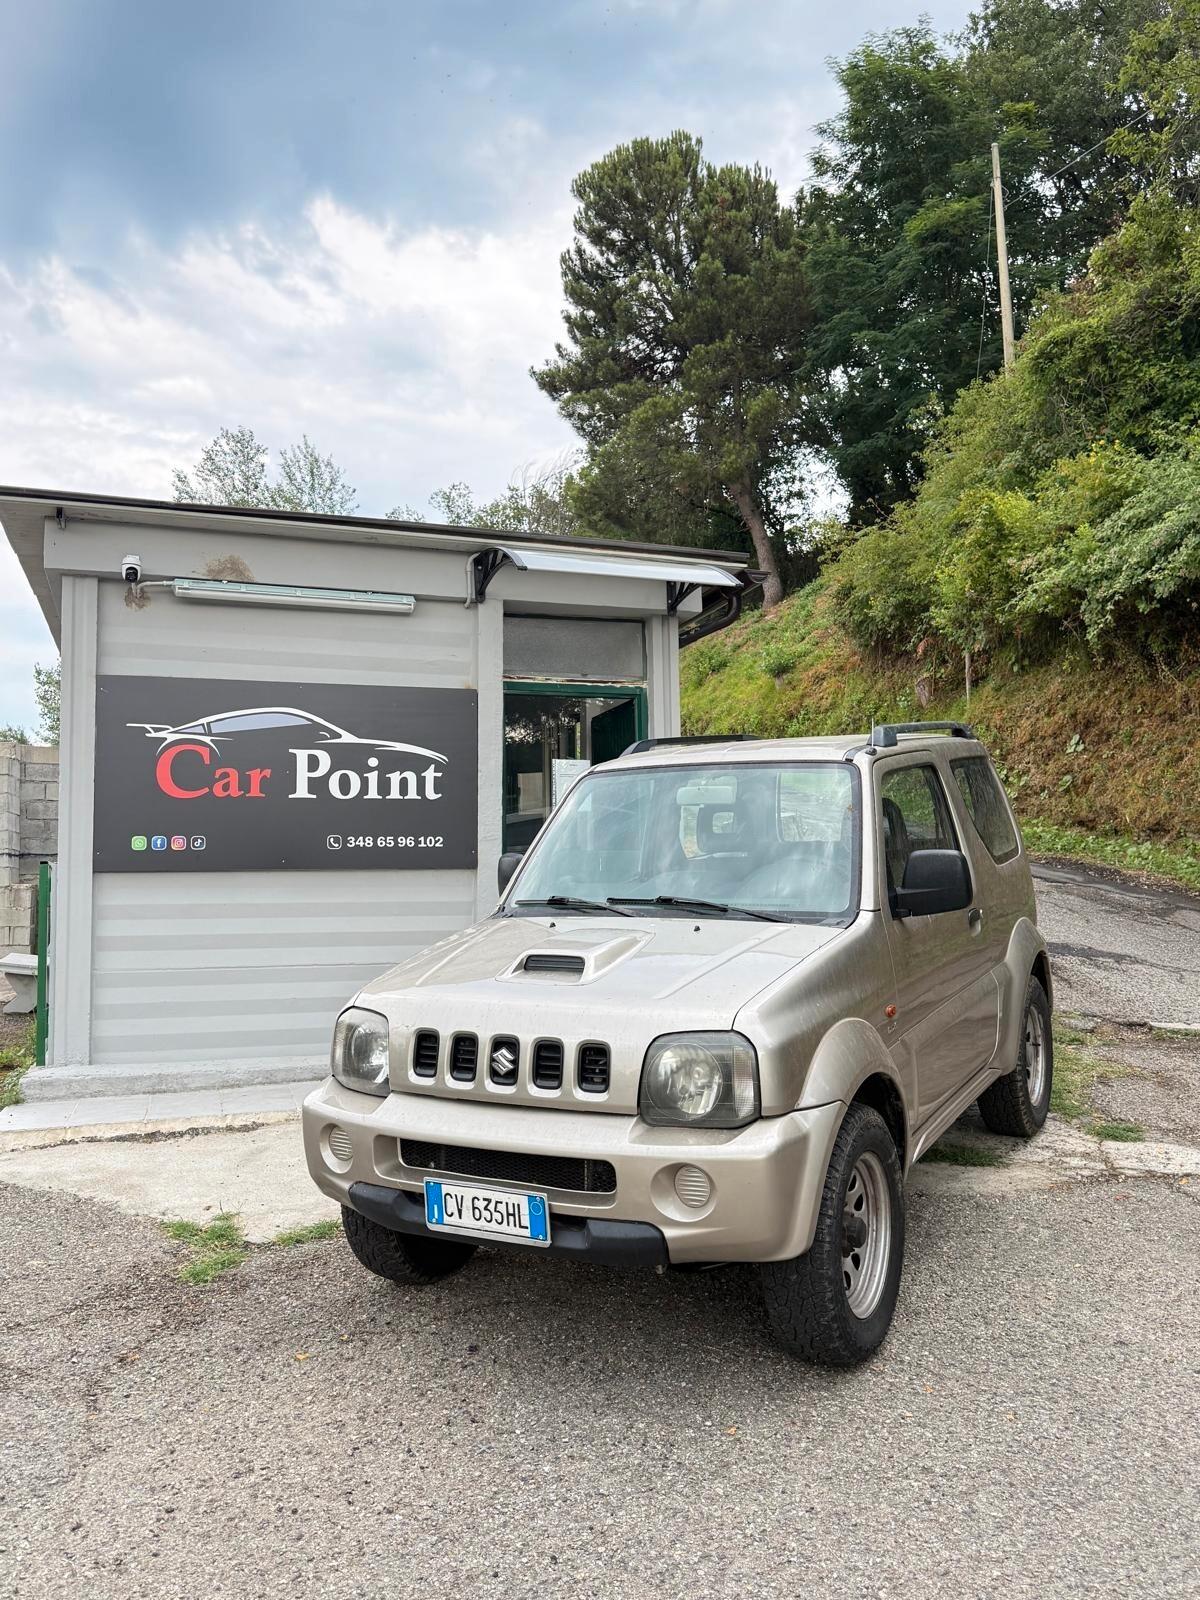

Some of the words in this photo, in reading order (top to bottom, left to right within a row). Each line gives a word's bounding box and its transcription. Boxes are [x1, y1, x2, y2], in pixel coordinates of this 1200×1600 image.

[155, 743, 272, 800] Car
[288, 748, 443, 801] Point
[346, 836, 374, 848] 348
[377, 836, 395, 848] 65
[397, 836, 415, 848] 96
[417, 836, 444, 848] 102
[443, 1192, 464, 1220] CV
[471, 1196, 529, 1230] 635HL
